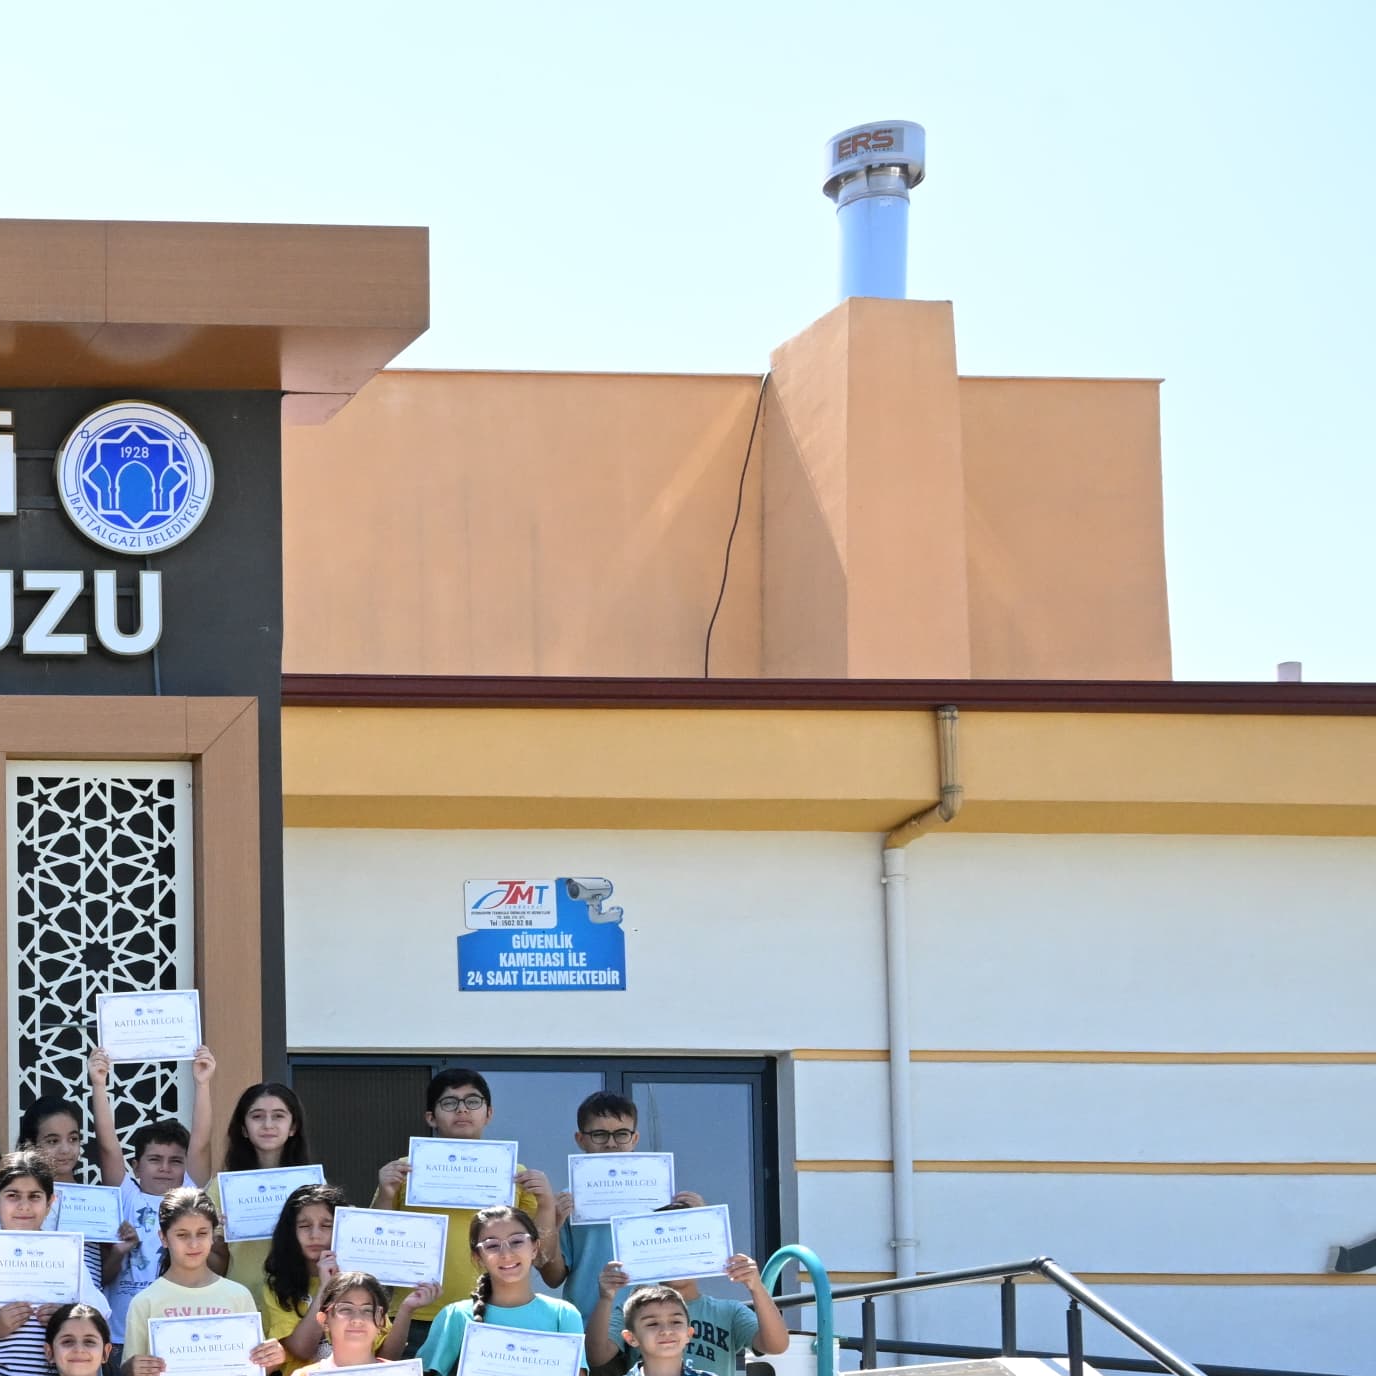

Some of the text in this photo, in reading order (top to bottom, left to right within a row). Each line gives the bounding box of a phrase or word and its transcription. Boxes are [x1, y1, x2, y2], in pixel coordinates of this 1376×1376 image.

[838, 129, 894, 158] ERS
[120, 447, 149, 459] 1928
[70, 496, 202, 547] BATTALGAZİ BELEDİYESİ
[512, 932, 573, 949] GÜVENLİK
[499, 952, 587, 967] KAMERASI İLE
[467, 967, 620, 985] 24 SAAT İZLENMEKTEDİR
[690, 1320, 730, 1352] ORK
[686, 1343, 715, 1361] TAR
